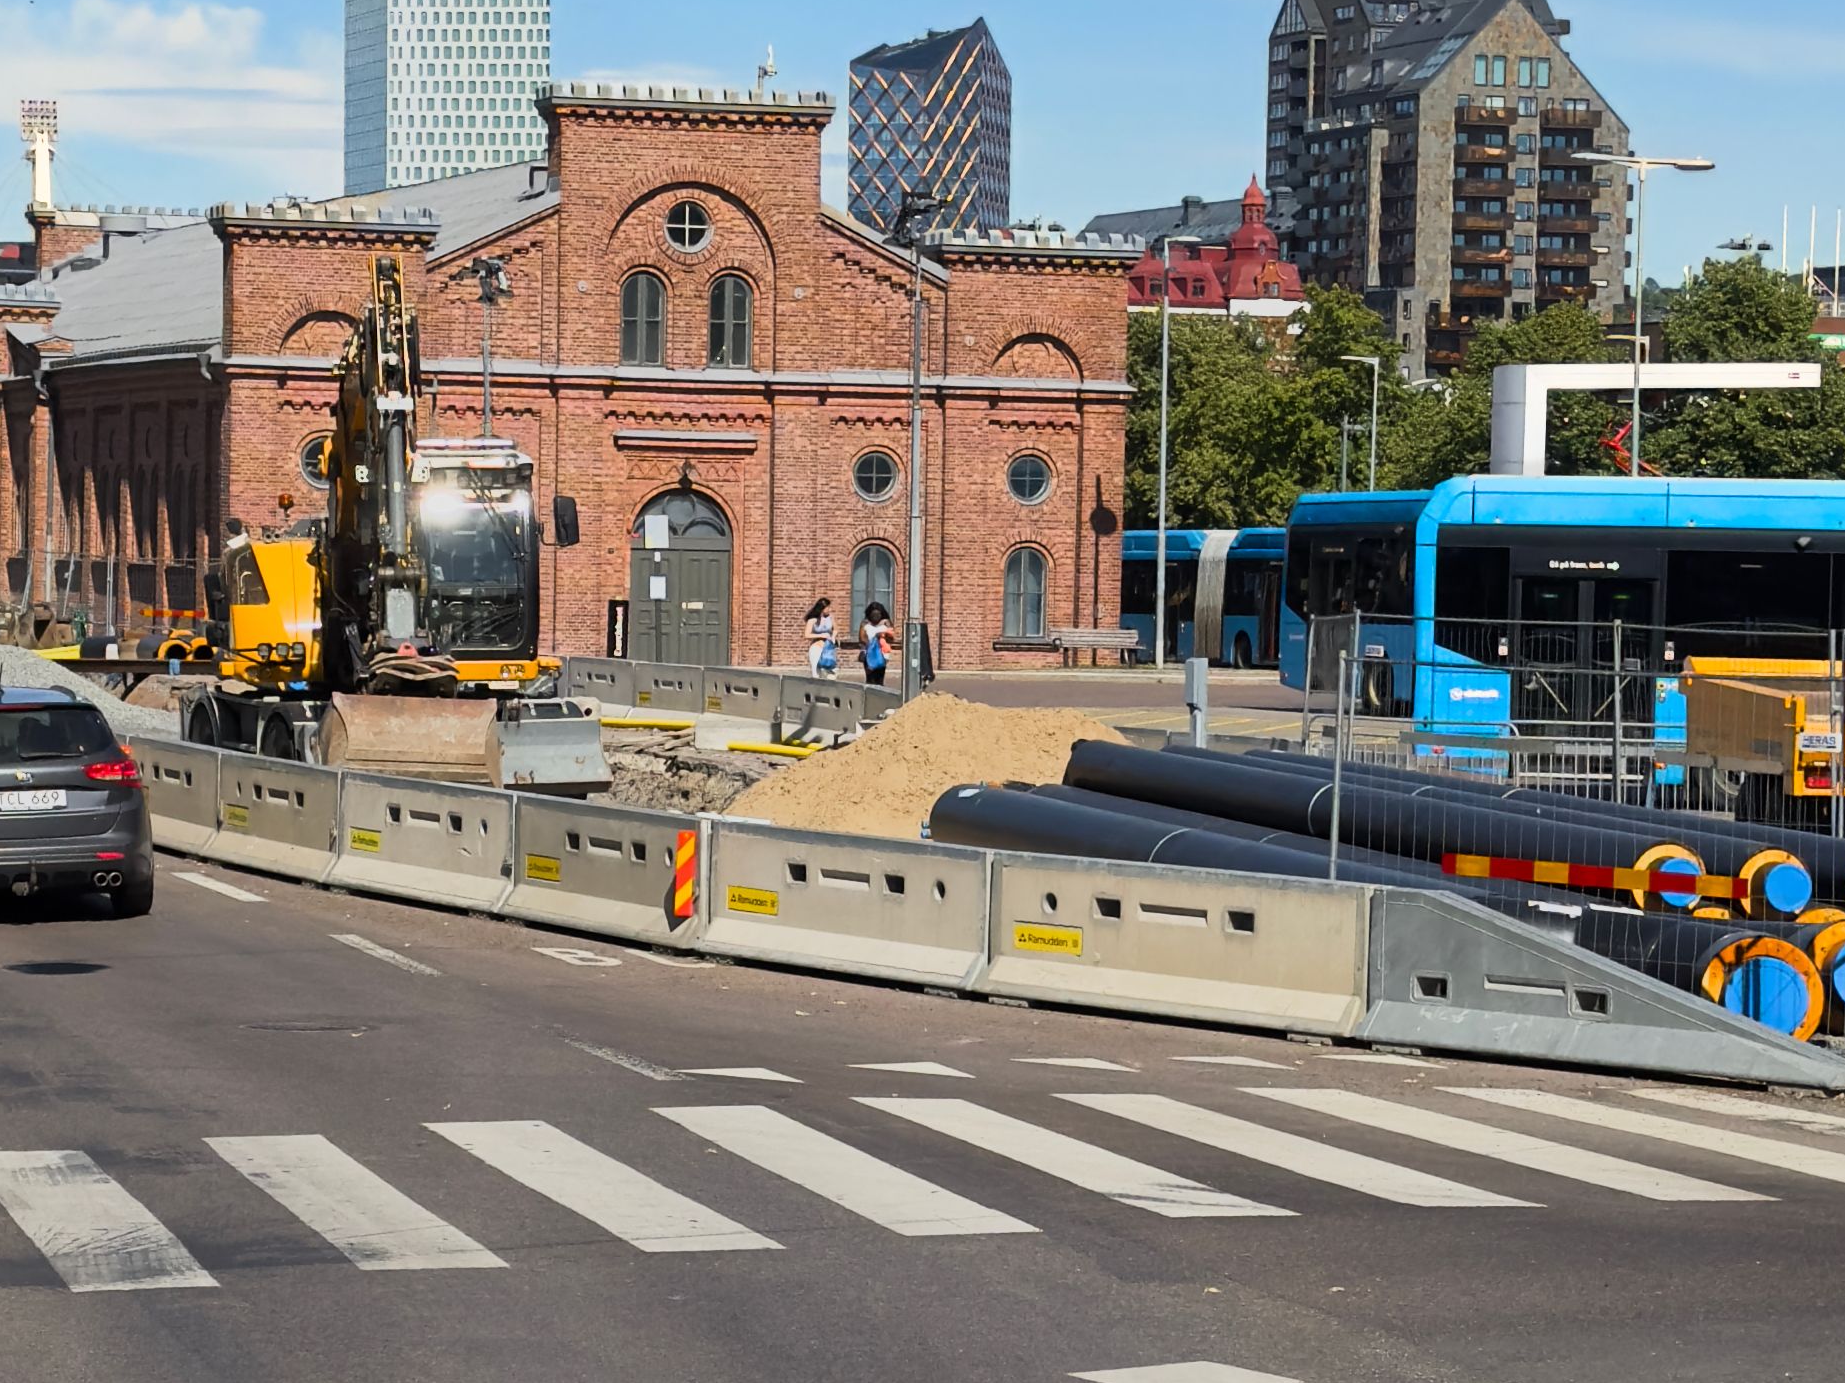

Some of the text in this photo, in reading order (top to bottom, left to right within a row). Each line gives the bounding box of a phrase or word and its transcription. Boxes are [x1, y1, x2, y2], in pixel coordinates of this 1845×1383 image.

[1803, 735, 1837, 745] HERAS
[31, 791, 60, 805] 669
[1028, 932, 1068, 948] Ramudden
[530, 946, 716, 969] BU
